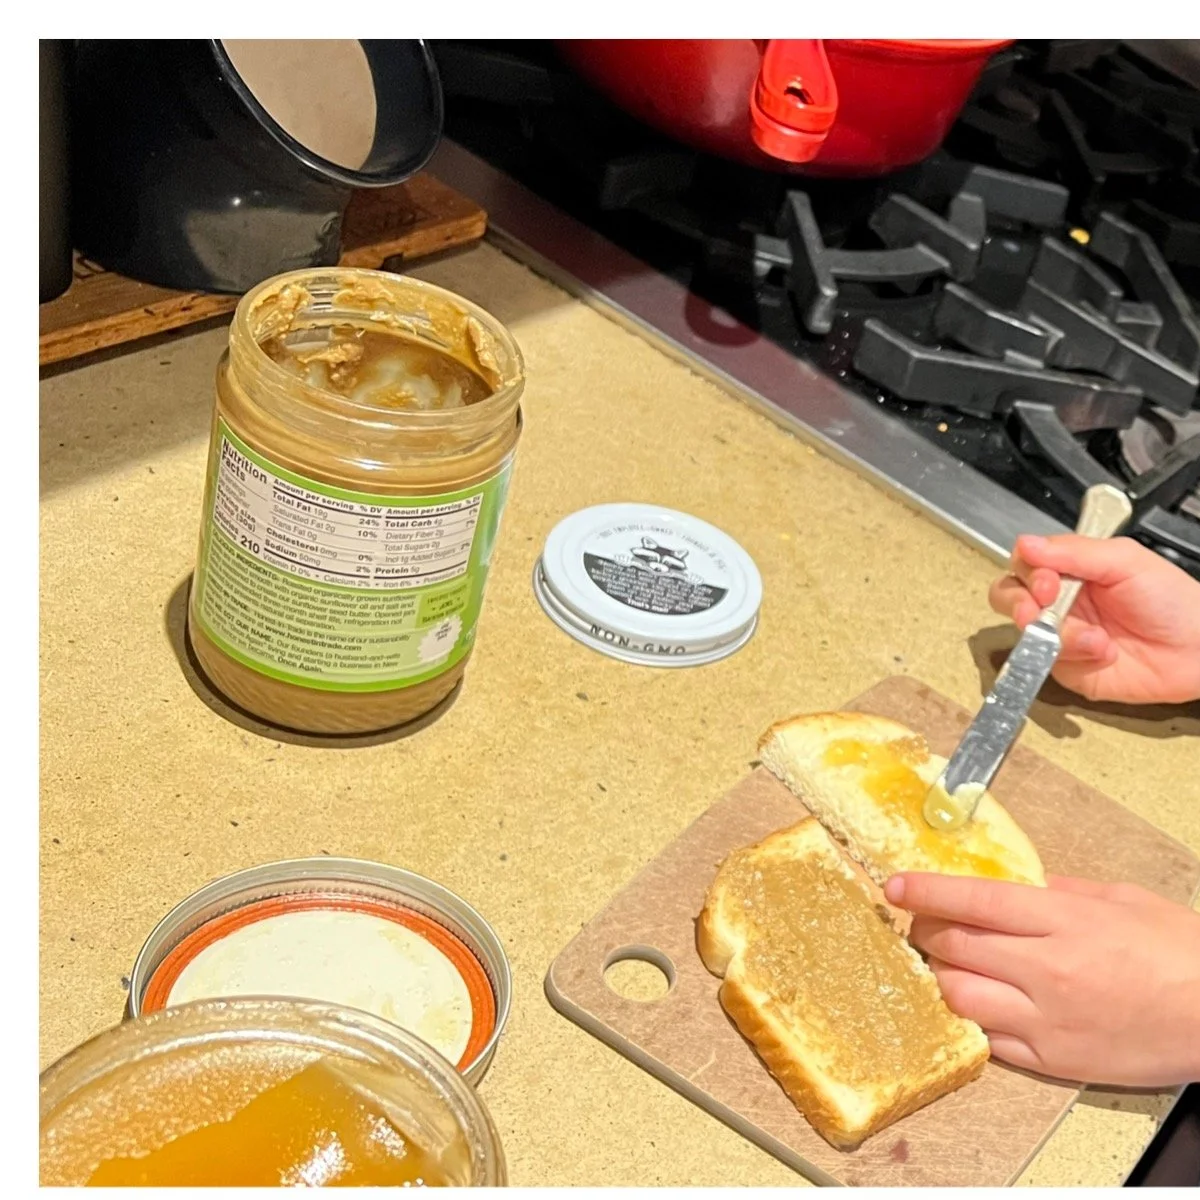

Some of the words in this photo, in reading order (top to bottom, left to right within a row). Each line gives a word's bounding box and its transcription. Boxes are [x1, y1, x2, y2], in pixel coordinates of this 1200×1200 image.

[221, 448, 245, 482] Facts
[223, 437, 267, 484] Nutrition
[217, 483, 239, 512] Serving
[240, 507, 256, 523] size
[272, 490, 294, 506] Total
[296, 501, 311, 512] Fat
[358, 518, 379, 526] 24%
[274, 477, 303, 495] Amount
[305, 492, 319, 501] per
[321, 497, 354, 510] serving
[420, 507, 433, 515] per
[435, 501, 462, 513] serving
[235, 511, 255, 533] (30g)
[271, 516, 291, 531] Trans
[293, 525, 305, 535] Fat
[307, 531, 317, 541] 0g
[273, 504, 309, 525] Saturated
[311, 519, 323, 528] Fat
[324, 523, 335, 533] 2g
[357, 530, 377, 538] 10%
[385, 532, 413, 540] Dietary
[240, 533, 260, 555] 210
[264, 538, 297, 558] Sodium
[355, 565, 370, 573] 2%
[266, 526, 318, 552] Cholesterol
[319, 547, 337, 558] 0mg
[403, 542, 430, 552] Sugars
[263, 553, 288, 569] Vitamin
[297, 568, 310, 577] 0%
[323, 574, 355, 585] Calcium
[590, 623, 686, 654] NON-GMO
